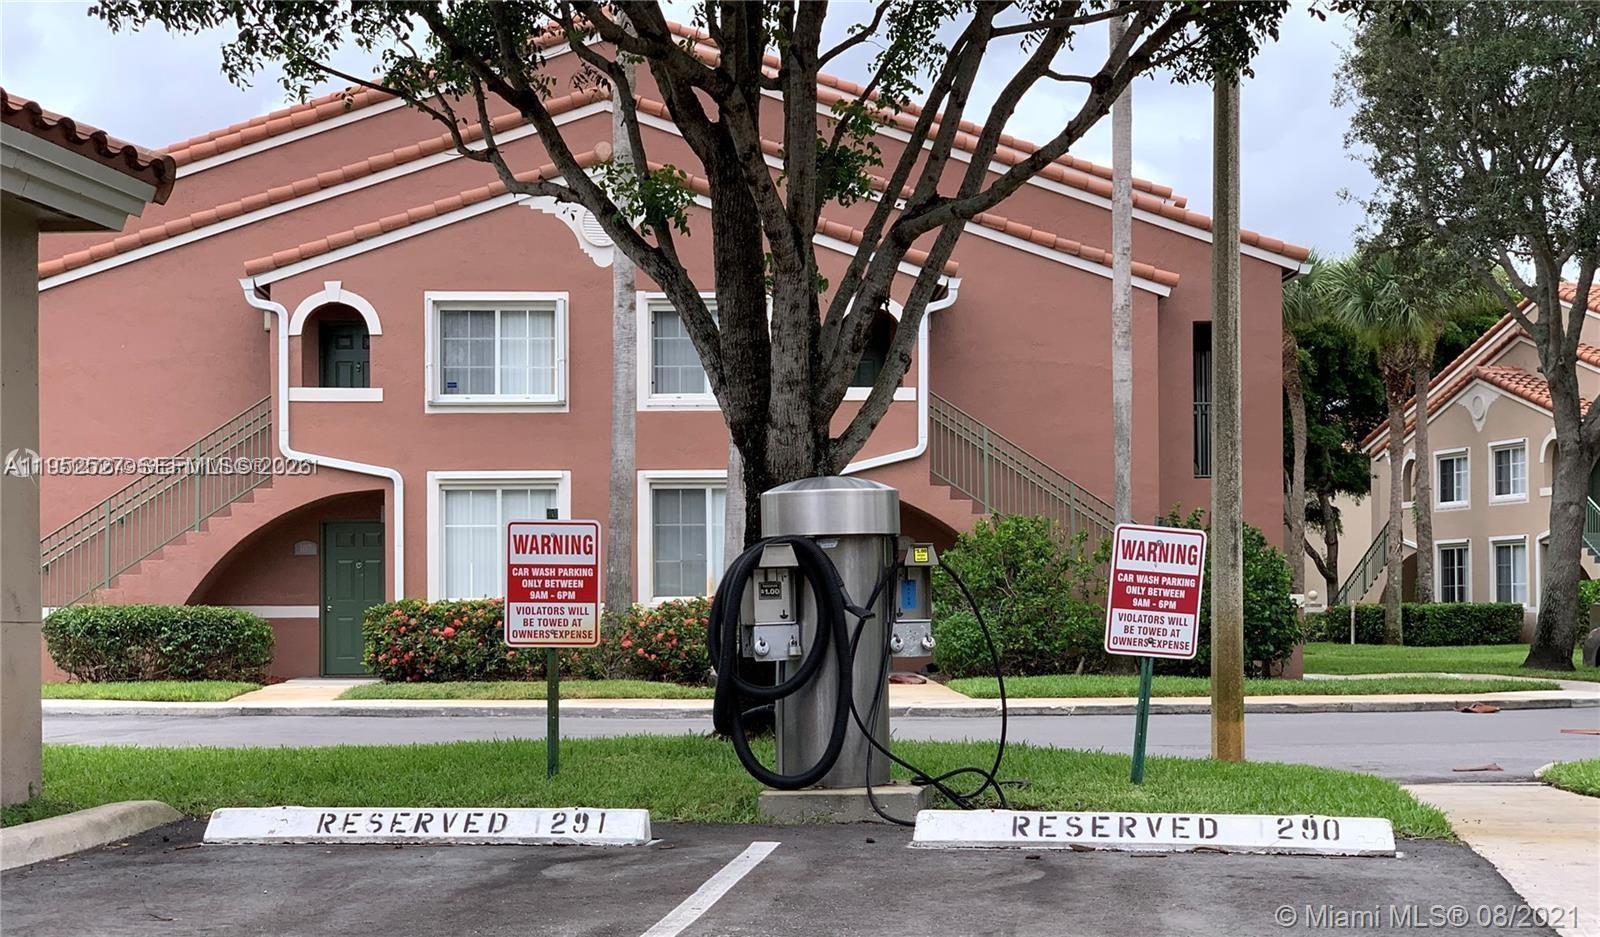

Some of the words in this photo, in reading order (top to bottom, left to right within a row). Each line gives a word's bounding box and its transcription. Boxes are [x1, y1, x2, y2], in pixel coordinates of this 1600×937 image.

[513, 533, 593, 555] WARNING
[1121, 539, 1198, 566] WARNING
[512, 568, 529, 577] CAR
[531, 568, 556, 577] WASH
[557, 568, 593, 577] PARKING
[522, 579, 542, 588] ONLY
[545, 579, 584, 588] BETWEEN
[1117, 573, 1134, 582] CAR
[1136, 574, 1159, 584] WASH
[1161, 576, 1196, 587] PARKING
[529, 591, 548, 600] 9AM
[556, 591, 576, 600] 6PM
[1126, 585, 1145, 595] ONLY
[1147, 588, 1185, 598] BETWEEN
[1132, 599, 1151, 608] 9AM
[1158, 601, 1177, 609] 6PM
[516, 606, 565, 616] VIOLATORS
[567, 606, 589, 616] WILL
[523, 618, 534, 627] BE
[537, 618, 569, 627] TOWED
[571, 618, 583, 627] AT
[1118, 612, 1165, 625] VIOLATORS
[1167, 616, 1188, 627] WILL
[512, 629, 551, 639] OWNERS
[554, 629, 593, 639] EXPENSE
[1123, 625, 1135, 635] BE
[1138, 626, 1168, 637] TOWED
[1170, 628, 1181, 638] AT
[1112, 636, 1149, 648] OWNERS
[1152, 638, 1190, 650] EXPENSE
[316, 812, 509, 834] RESERVED
[550, 811, 607, 835] 291
[1011, 815, 1219, 841] RESERVED
[1277, 816, 1341, 842] 290
